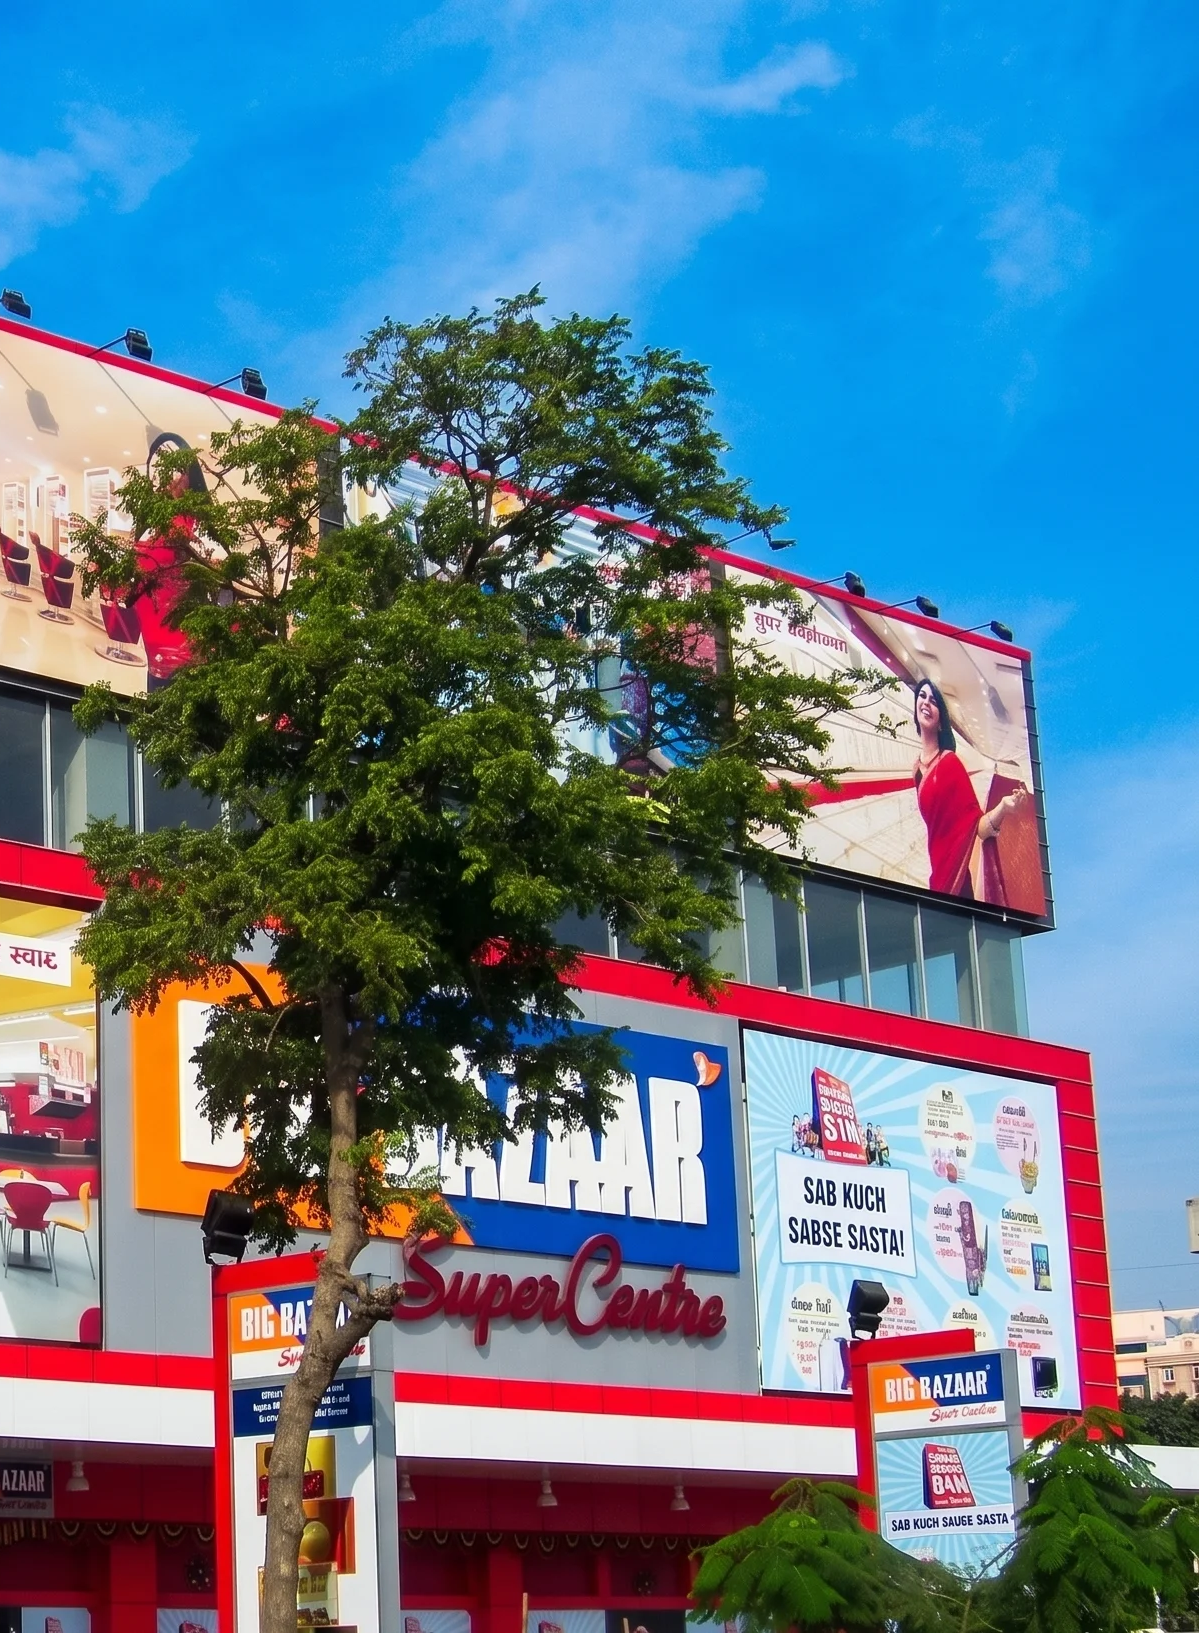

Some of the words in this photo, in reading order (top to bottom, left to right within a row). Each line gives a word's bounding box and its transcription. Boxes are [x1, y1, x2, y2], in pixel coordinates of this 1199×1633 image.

[803, 1176, 837, 1207] SAB
[842, 1182, 887, 1213] KUCH
[788, 1216, 843, 1248] SABSE
[847, 1223, 905, 1257] SASTA!
[241, 1304, 275, 1342] BIG
[884, 1377, 915, 1403] BIG
[919, 1370, 988, 1400] BAZAAR
[891, 1518, 911, 1532] SAB
[913, 1516, 940, 1530] KUCH
[976, 1512, 1009, 1526] SASTA
